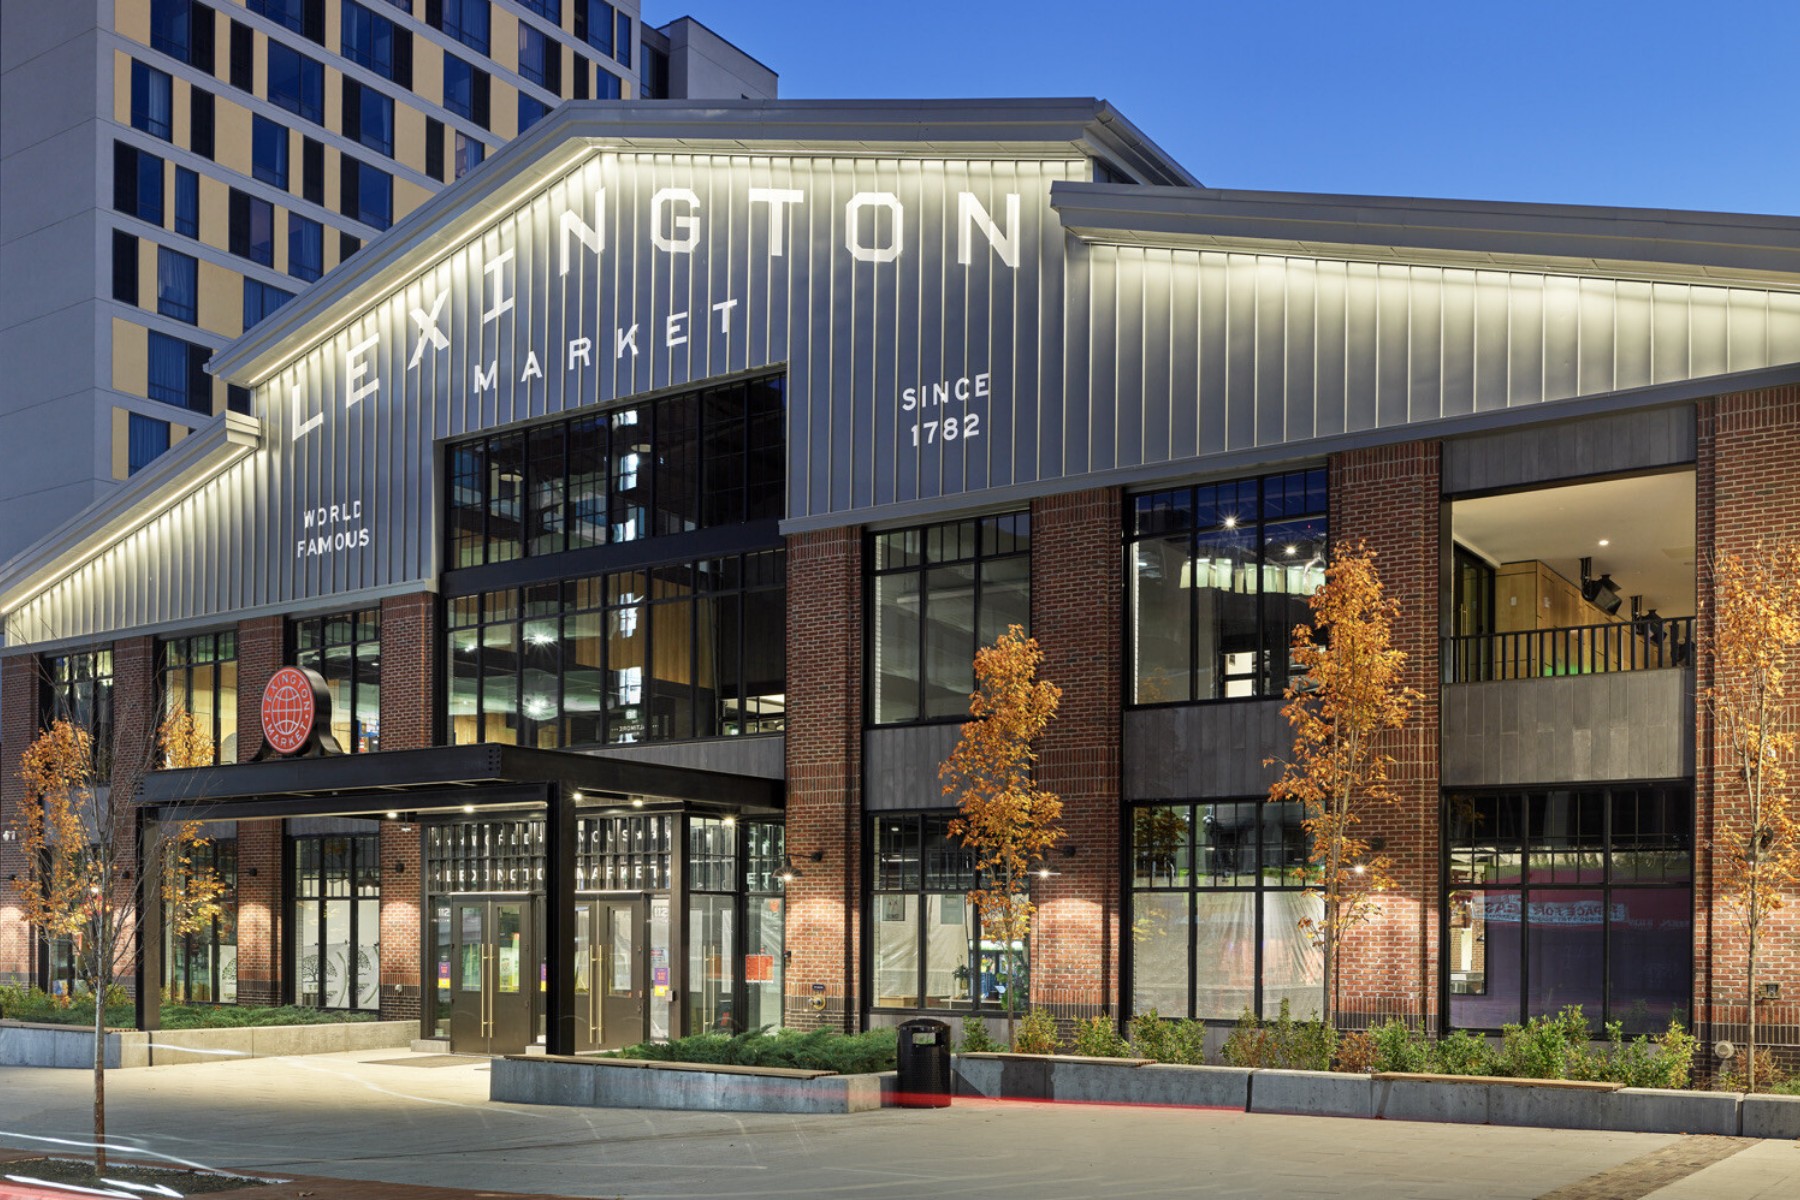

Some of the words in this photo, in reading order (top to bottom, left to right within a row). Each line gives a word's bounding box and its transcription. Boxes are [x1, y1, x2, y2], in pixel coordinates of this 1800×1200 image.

[292, 187, 1020, 442] LEXINGTON
[474, 298, 738, 394] MARKET
[902, 373, 989, 411] SINCE
[911, 413, 980, 447] 1782
[304, 500, 361, 528] WORLD
[297, 528, 370, 558] FAMOUS
[264, 674, 310, 713] LEXINGTON
[267, 721, 307, 747] MARKET
